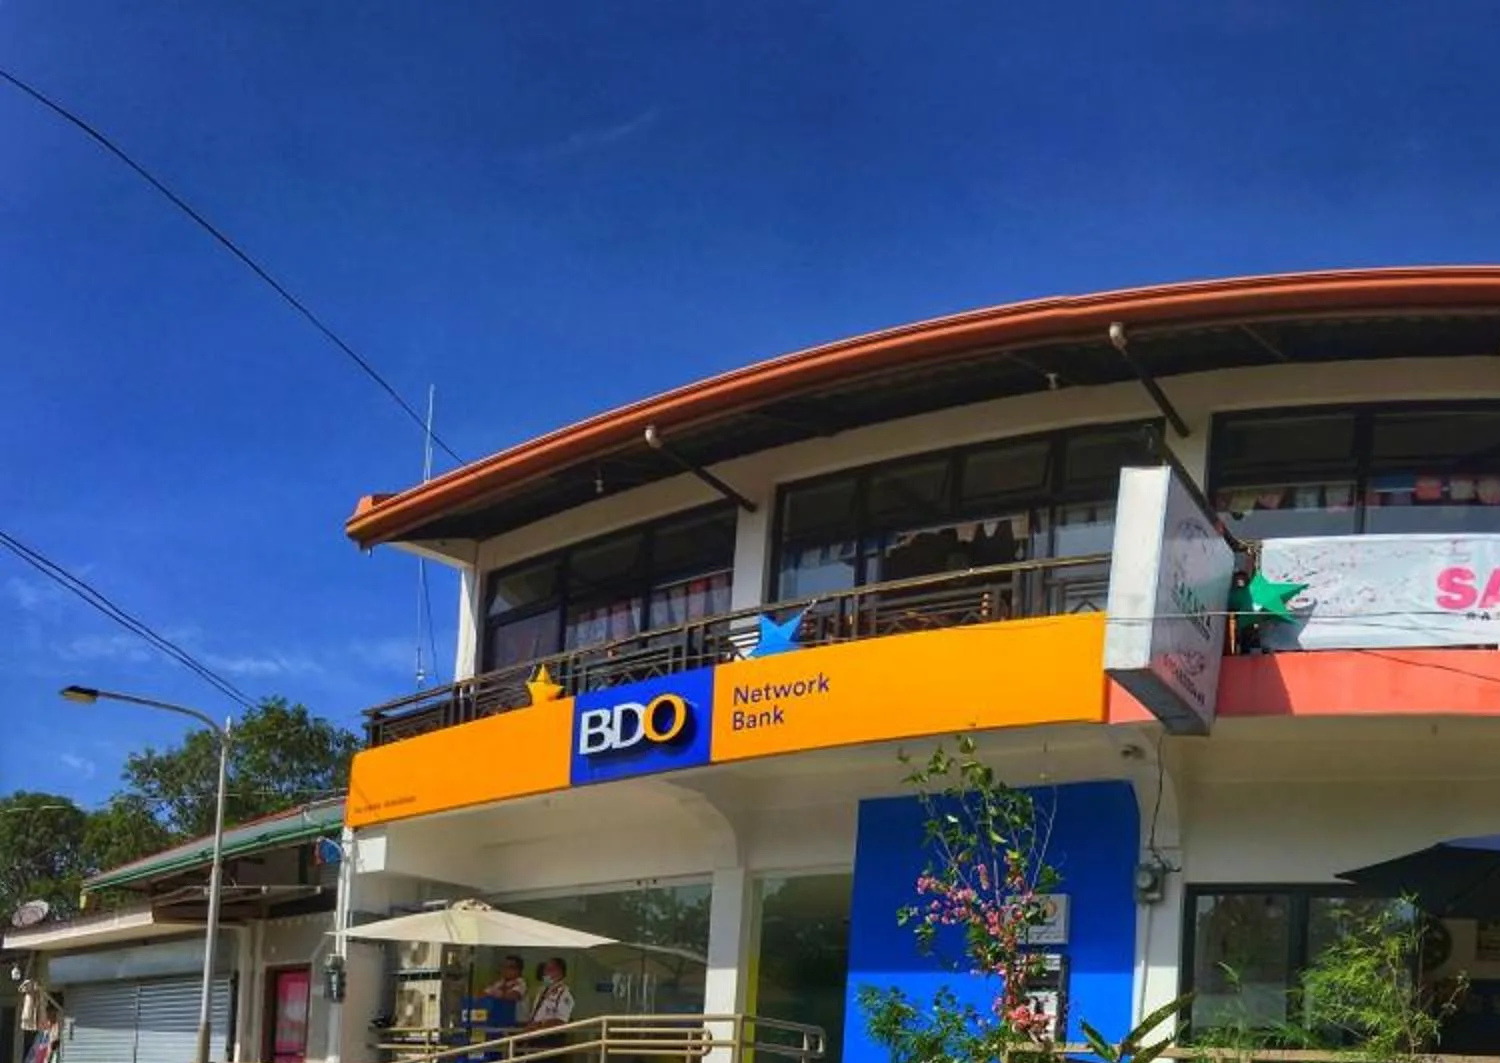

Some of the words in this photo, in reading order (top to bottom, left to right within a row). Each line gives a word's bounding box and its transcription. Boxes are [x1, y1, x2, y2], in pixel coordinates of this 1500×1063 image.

[732, 672, 830, 705] Network
[578, 693, 687, 755] BDO
[732, 705, 785, 731] Bank
